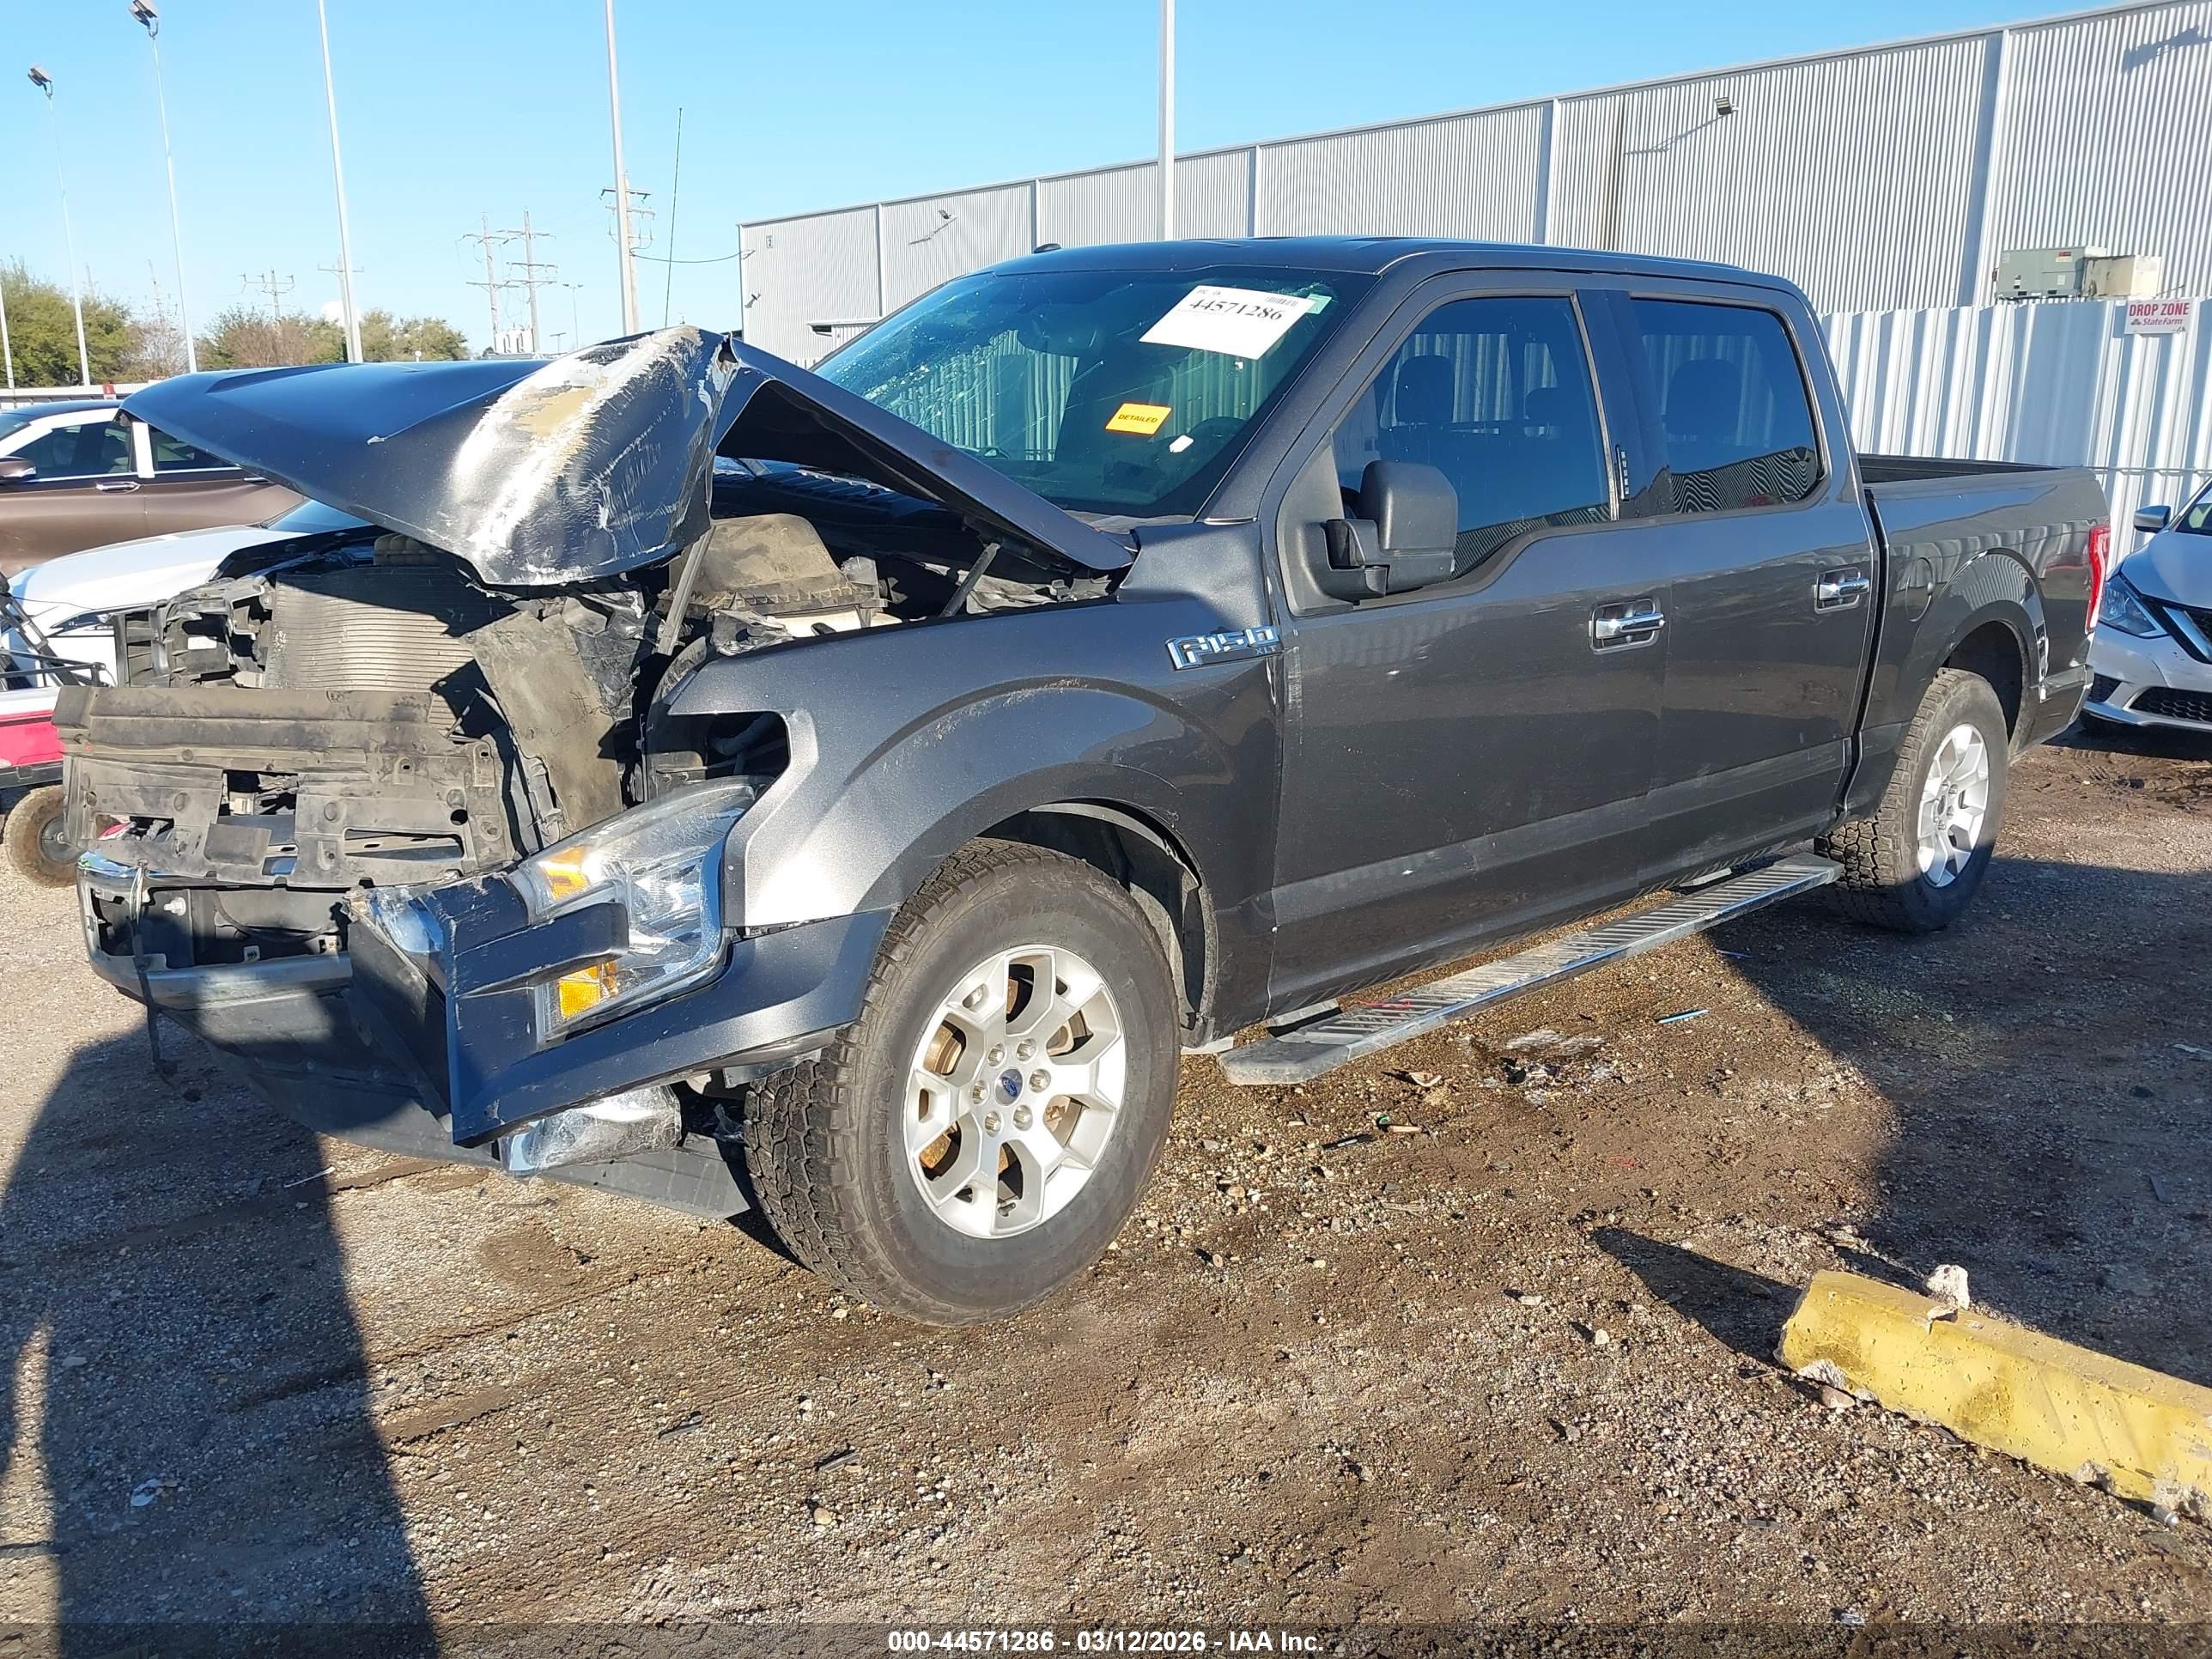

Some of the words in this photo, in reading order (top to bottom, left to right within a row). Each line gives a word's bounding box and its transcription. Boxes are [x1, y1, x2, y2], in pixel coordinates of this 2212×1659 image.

[1189, 298, 1283, 321] 44571286
[2129, 304, 2159, 318] DROP
[2160, 302, 2191, 317] ZONE
[1118, 413, 1158, 423] DETAILED
[1255, 645, 1277, 654] XLT
